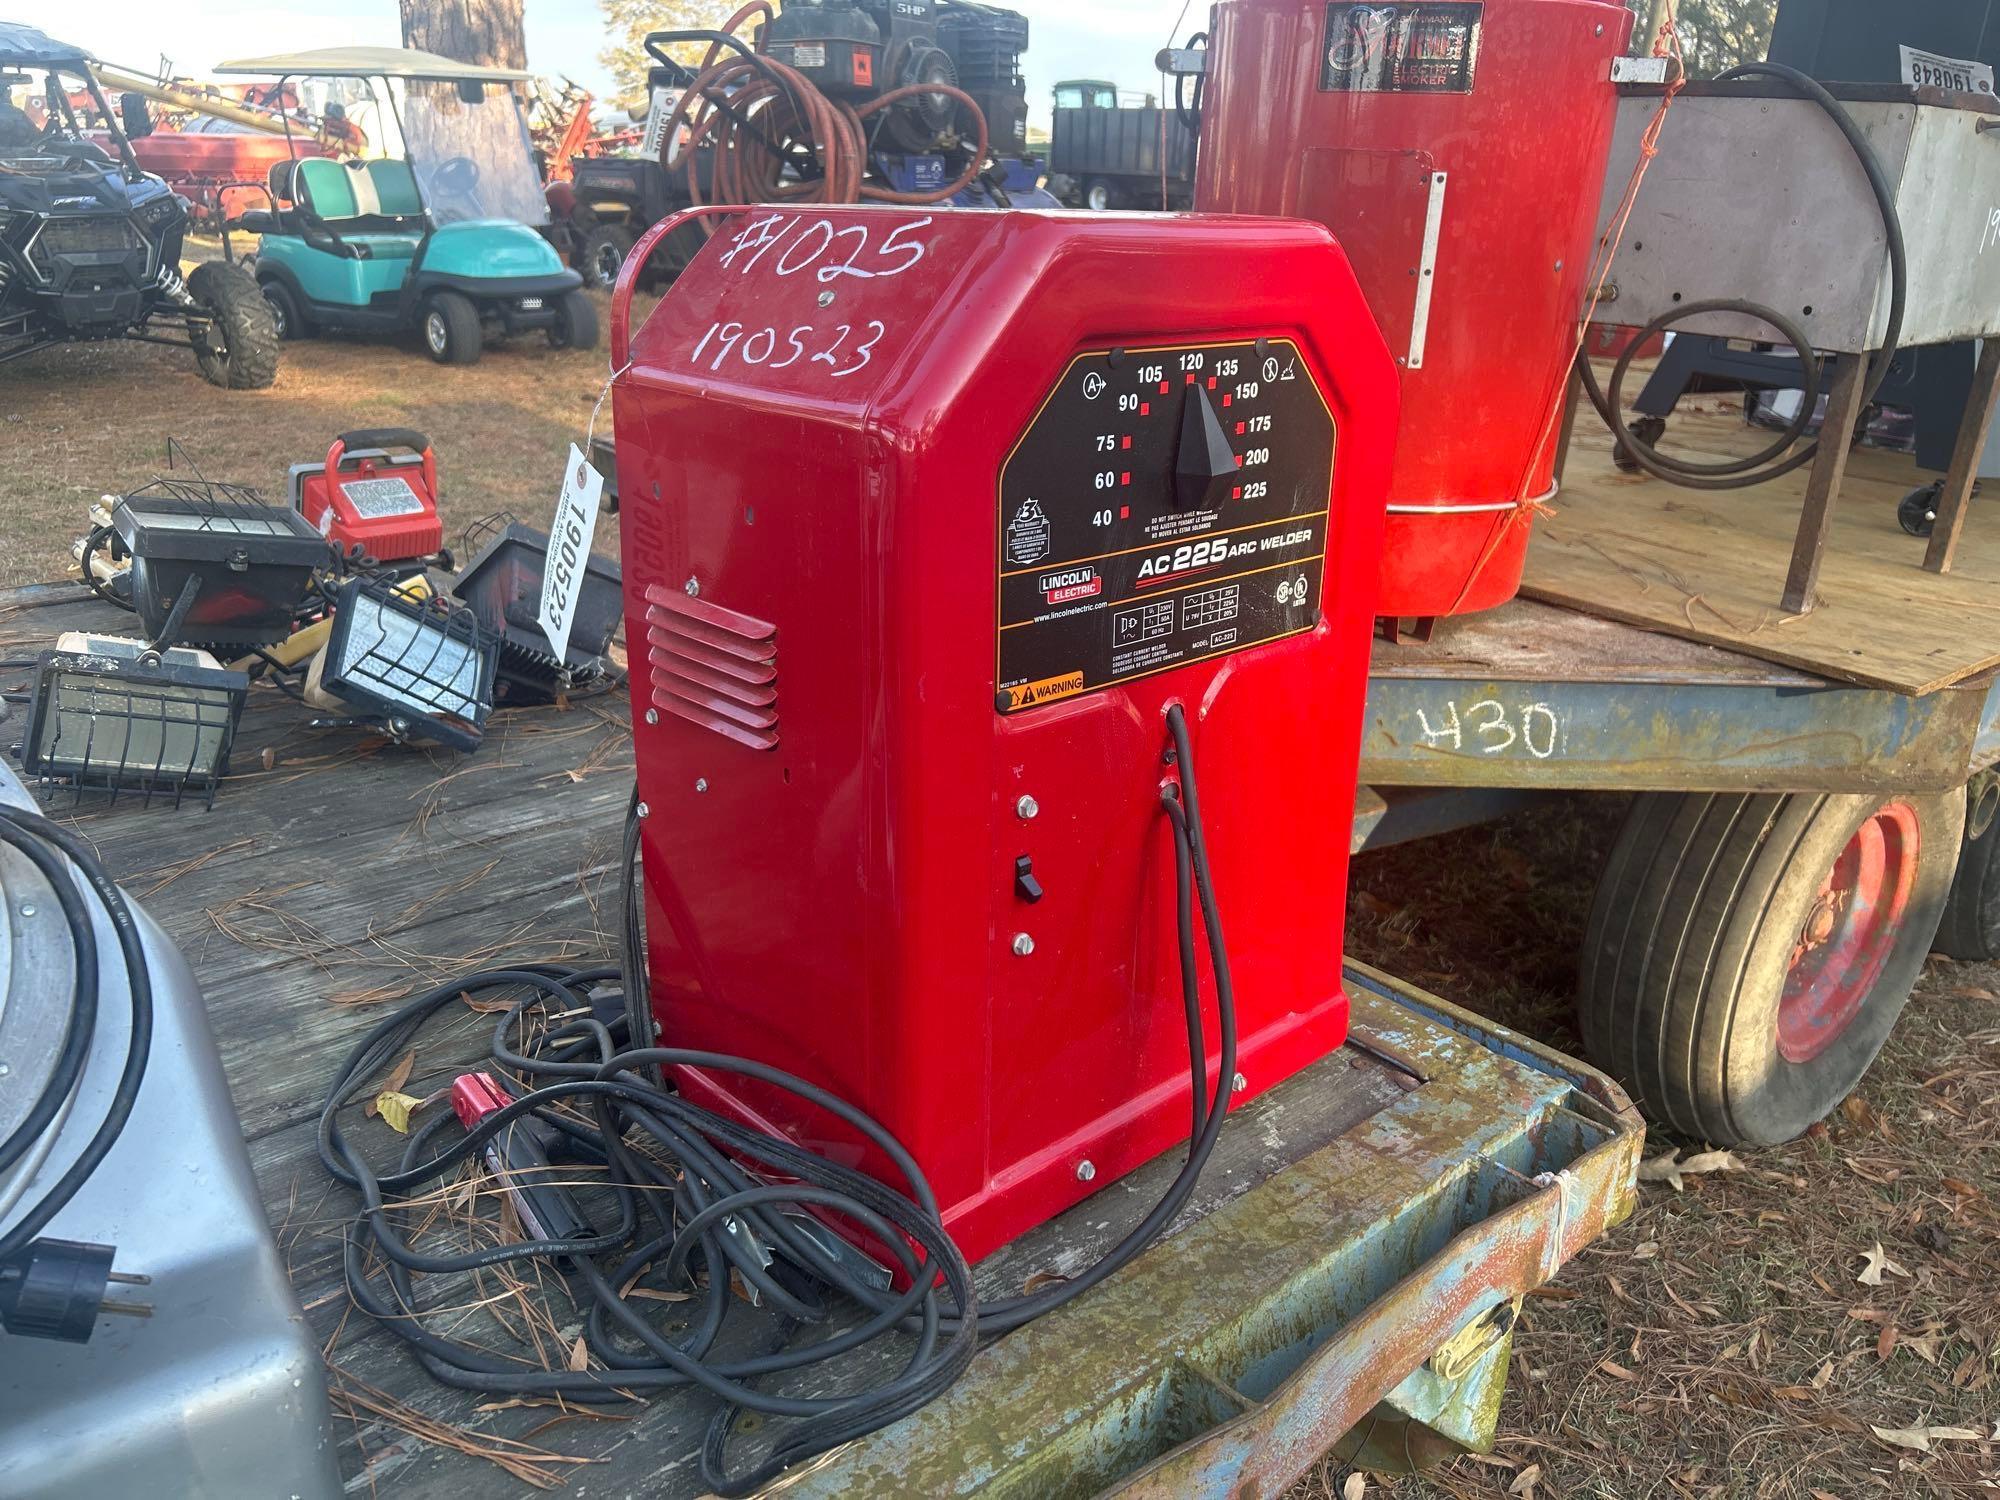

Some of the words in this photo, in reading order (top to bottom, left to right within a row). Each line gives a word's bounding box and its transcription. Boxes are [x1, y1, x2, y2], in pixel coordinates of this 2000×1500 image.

[1392, 63, 1459, 75] ELECTRIC
[1911, 62, 1974, 93] 190848
[1392, 75, 1447, 85] SMOKER
[719, 213, 933, 282] #1025
[690, 319, 886, 377] 190523
[1179, 353, 1204, 370] 120
[1215, 359, 1239, 377] 135
[1137, 366, 1163, 383] 105
[1235, 382, 1259, 399] 150
[1118, 394, 1138, 411] 90
[1249, 415, 1271, 432] 175
[1096, 435, 1115, 451] 75
[1245, 448, 1269, 465] 200
[1095, 471, 1115, 489] 60
[1243, 482, 1267, 499] 225
[1092, 509, 1112, 526] 40
[552, 522, 564, 562] AUCTION
[1227, 540, 1257, 558] ARC
[1260, 529, 1312, 550] WELDER
[550, 503, 587, 632] 190523
[1042, 569, 1091, 590] LINCOLN
[1054, 583, 1096, 600] ELECTRIC
[1034, 601, 1108, 623] www.lincolnelectric.com
[1214, 633, 1233, 643] AC-225
[1036, 677, 1083, 699] WARNING
[1416, 700, 1558, 758] 430
